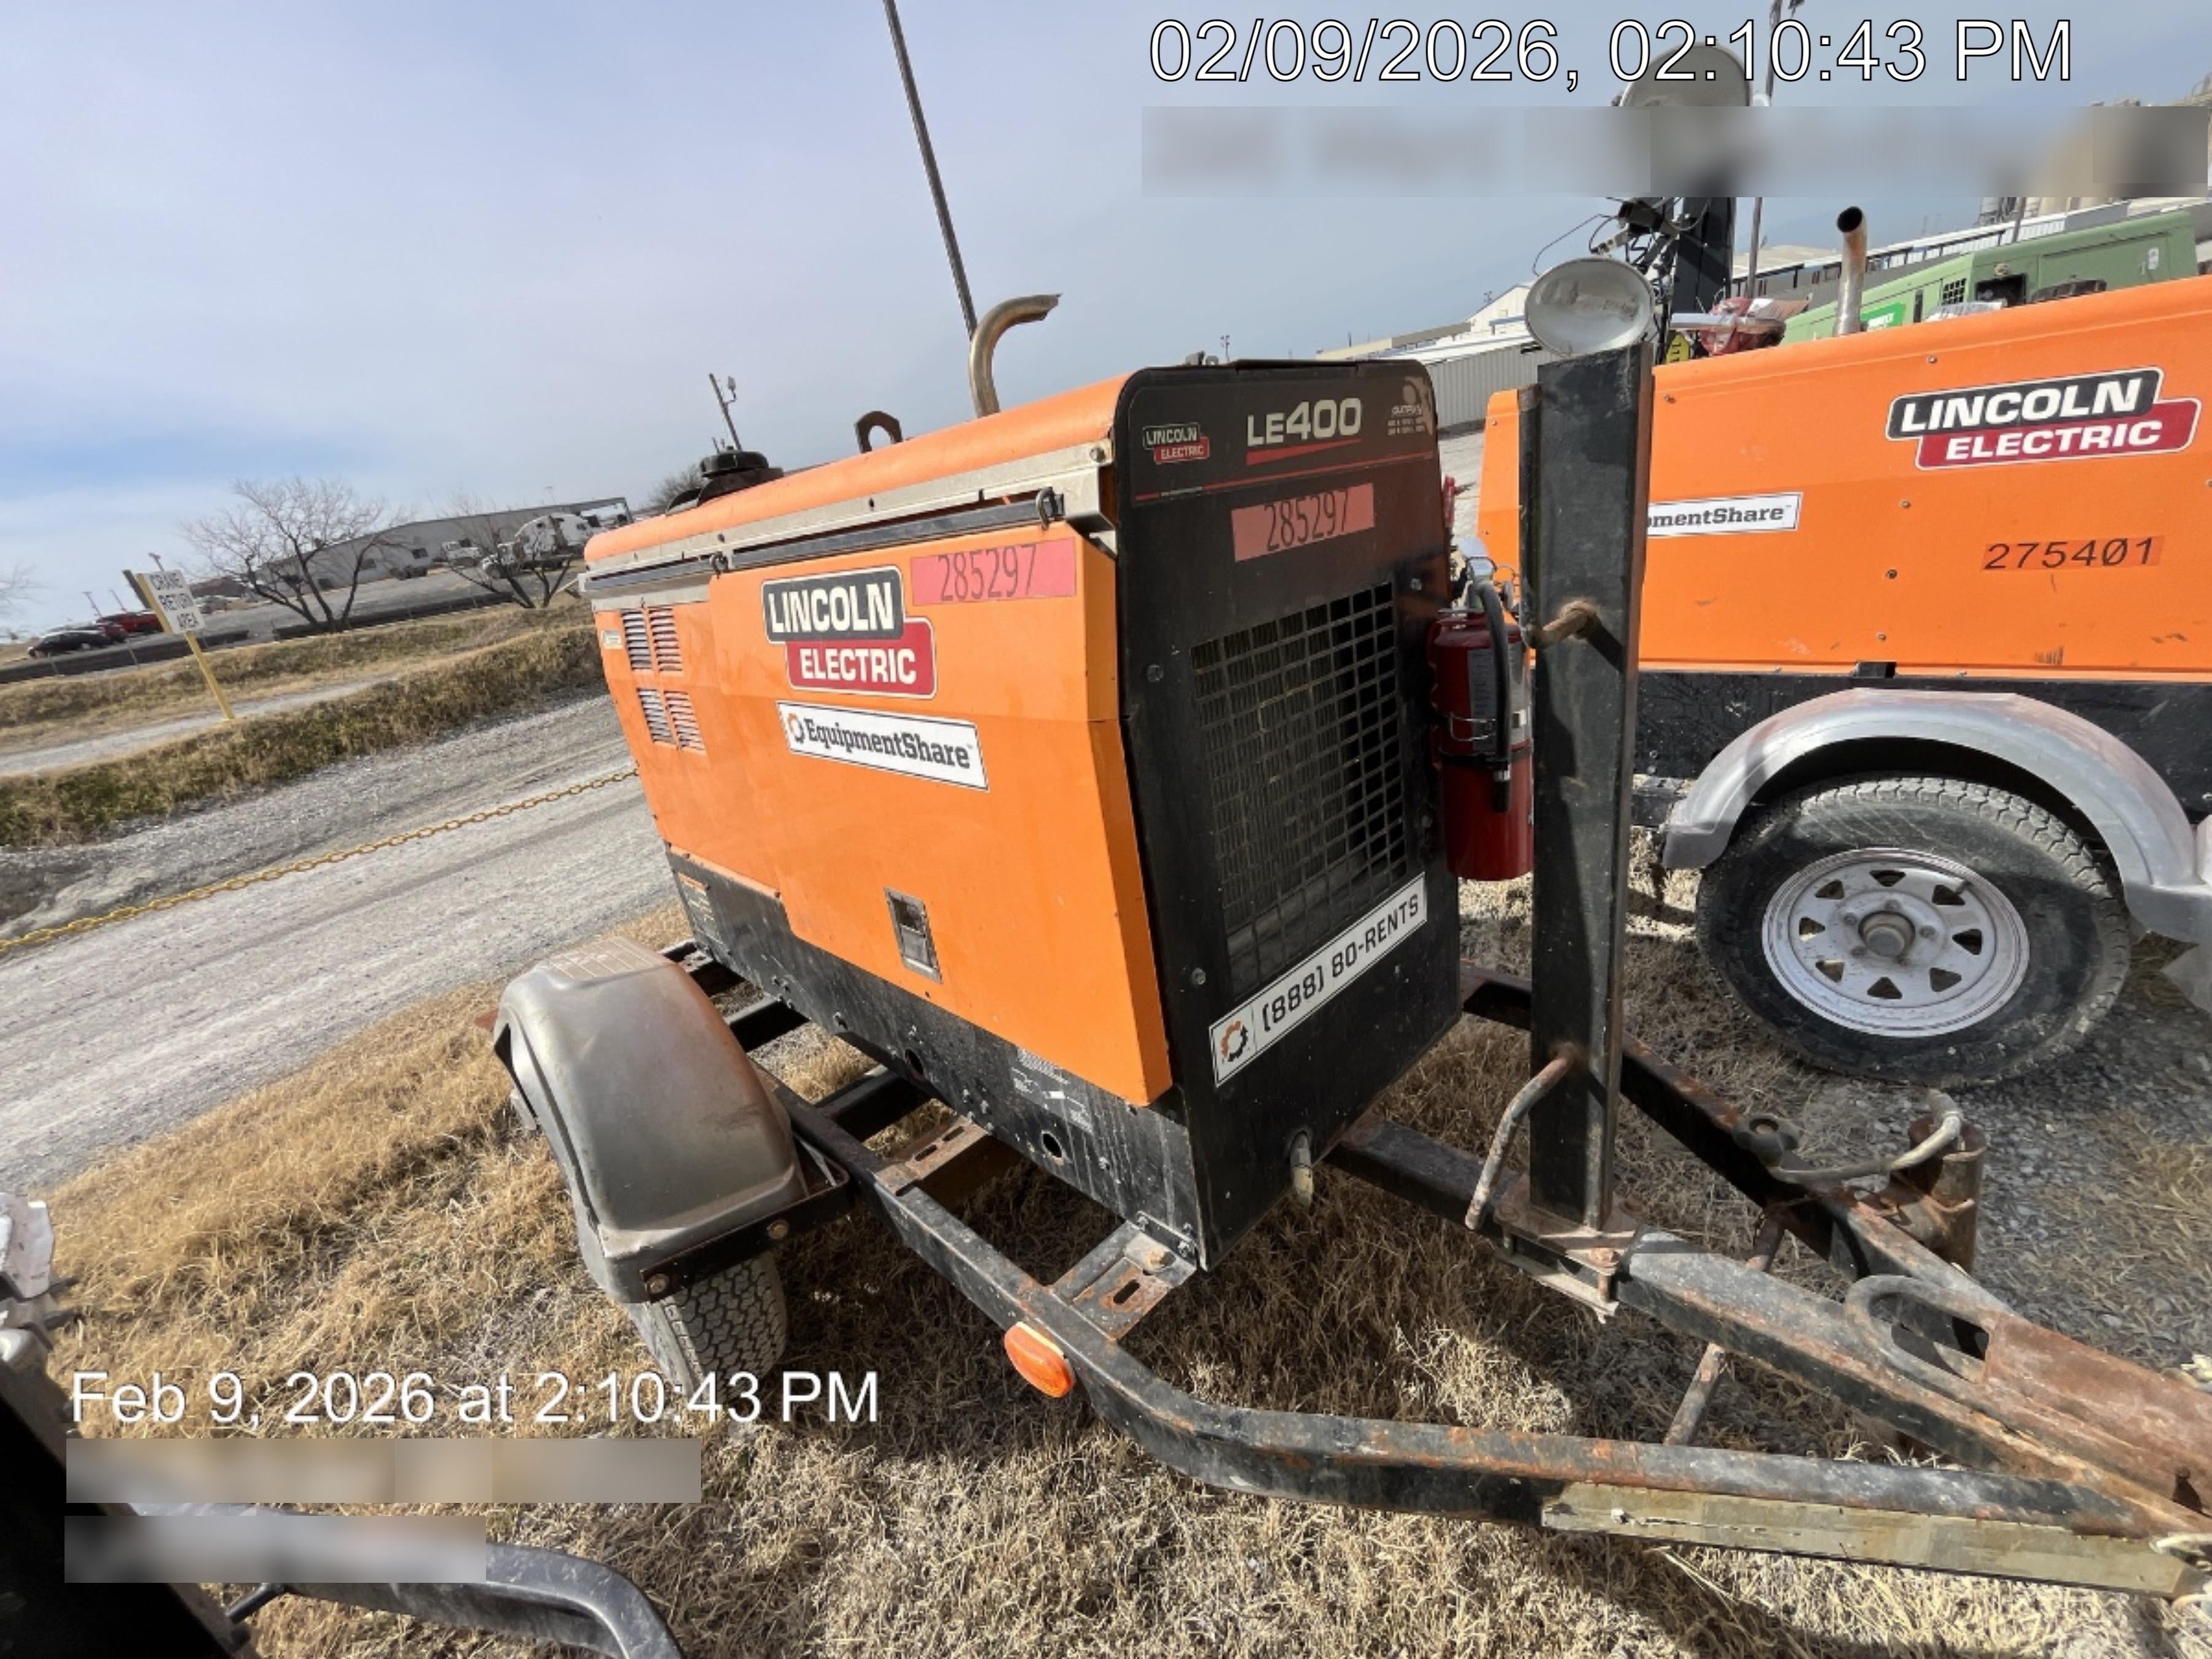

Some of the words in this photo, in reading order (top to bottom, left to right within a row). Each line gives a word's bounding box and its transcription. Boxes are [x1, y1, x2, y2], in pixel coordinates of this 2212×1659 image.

[1247, 398, 1362, 447] LE400
[1901, 378, 2142, 431] LINCOLN
[1145, 427, 1198, 445] LINCOLN
[1161, 446, 1204, 460] ELECTRIC
[1946, 420, 2162, 460] ELECTRIC
[1264, 490, 1349, 551] 285297
[938, 543, 1037, 602] 285297
[1983, 536, 2154, 570] 275401
[768, 581, 895, 633] LINCOLN
[800, 648, 917, 684] ELECTRIC
[804, 718, 971, 769] EquipmentShare
[1332, 894, 1419, 978] 80-RENTS
